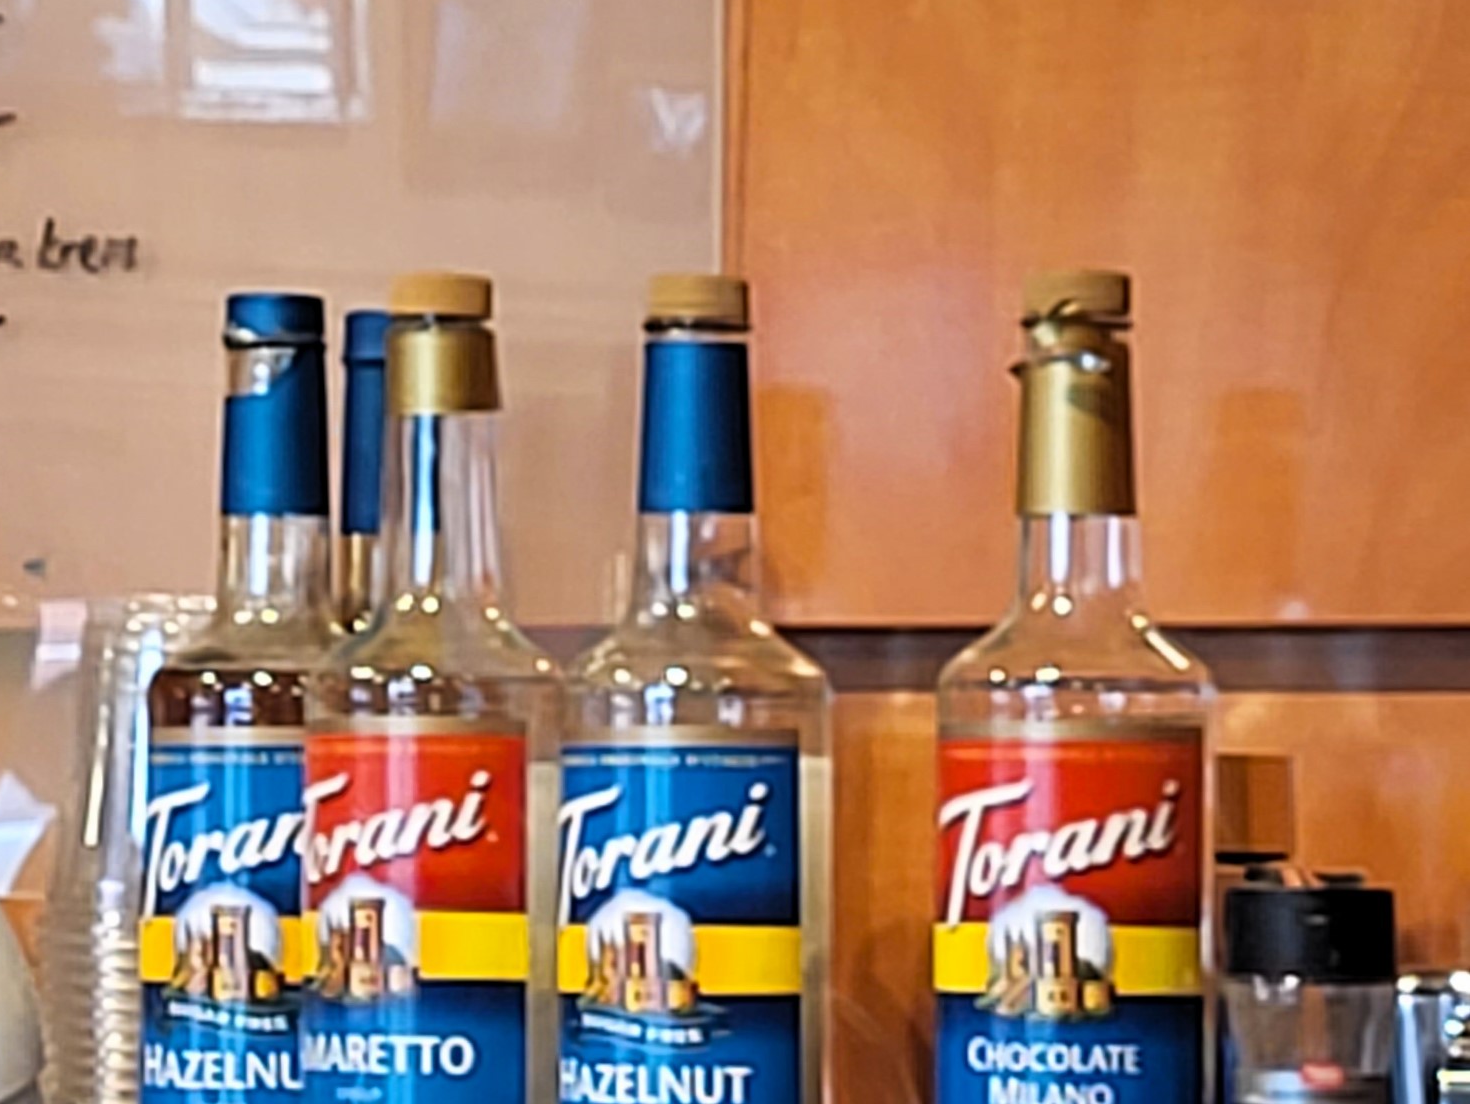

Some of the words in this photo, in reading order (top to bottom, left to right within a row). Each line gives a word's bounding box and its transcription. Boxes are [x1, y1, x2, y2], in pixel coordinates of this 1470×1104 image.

[144, 780, 305, 922] Toran
[558, 782, 769, 928] Torani
[938, 779, 1180, 930] Torani
[144, 1042, 305, 1090] HAZELNU
[301, 1032, 476, 1077] MARETTO
[966, 1035, 1142, 1074] CHOCOLATE
[559, 1056, 755, 1104] HAZELNUT
[988, 1075, 1115, 1104] MILANO
